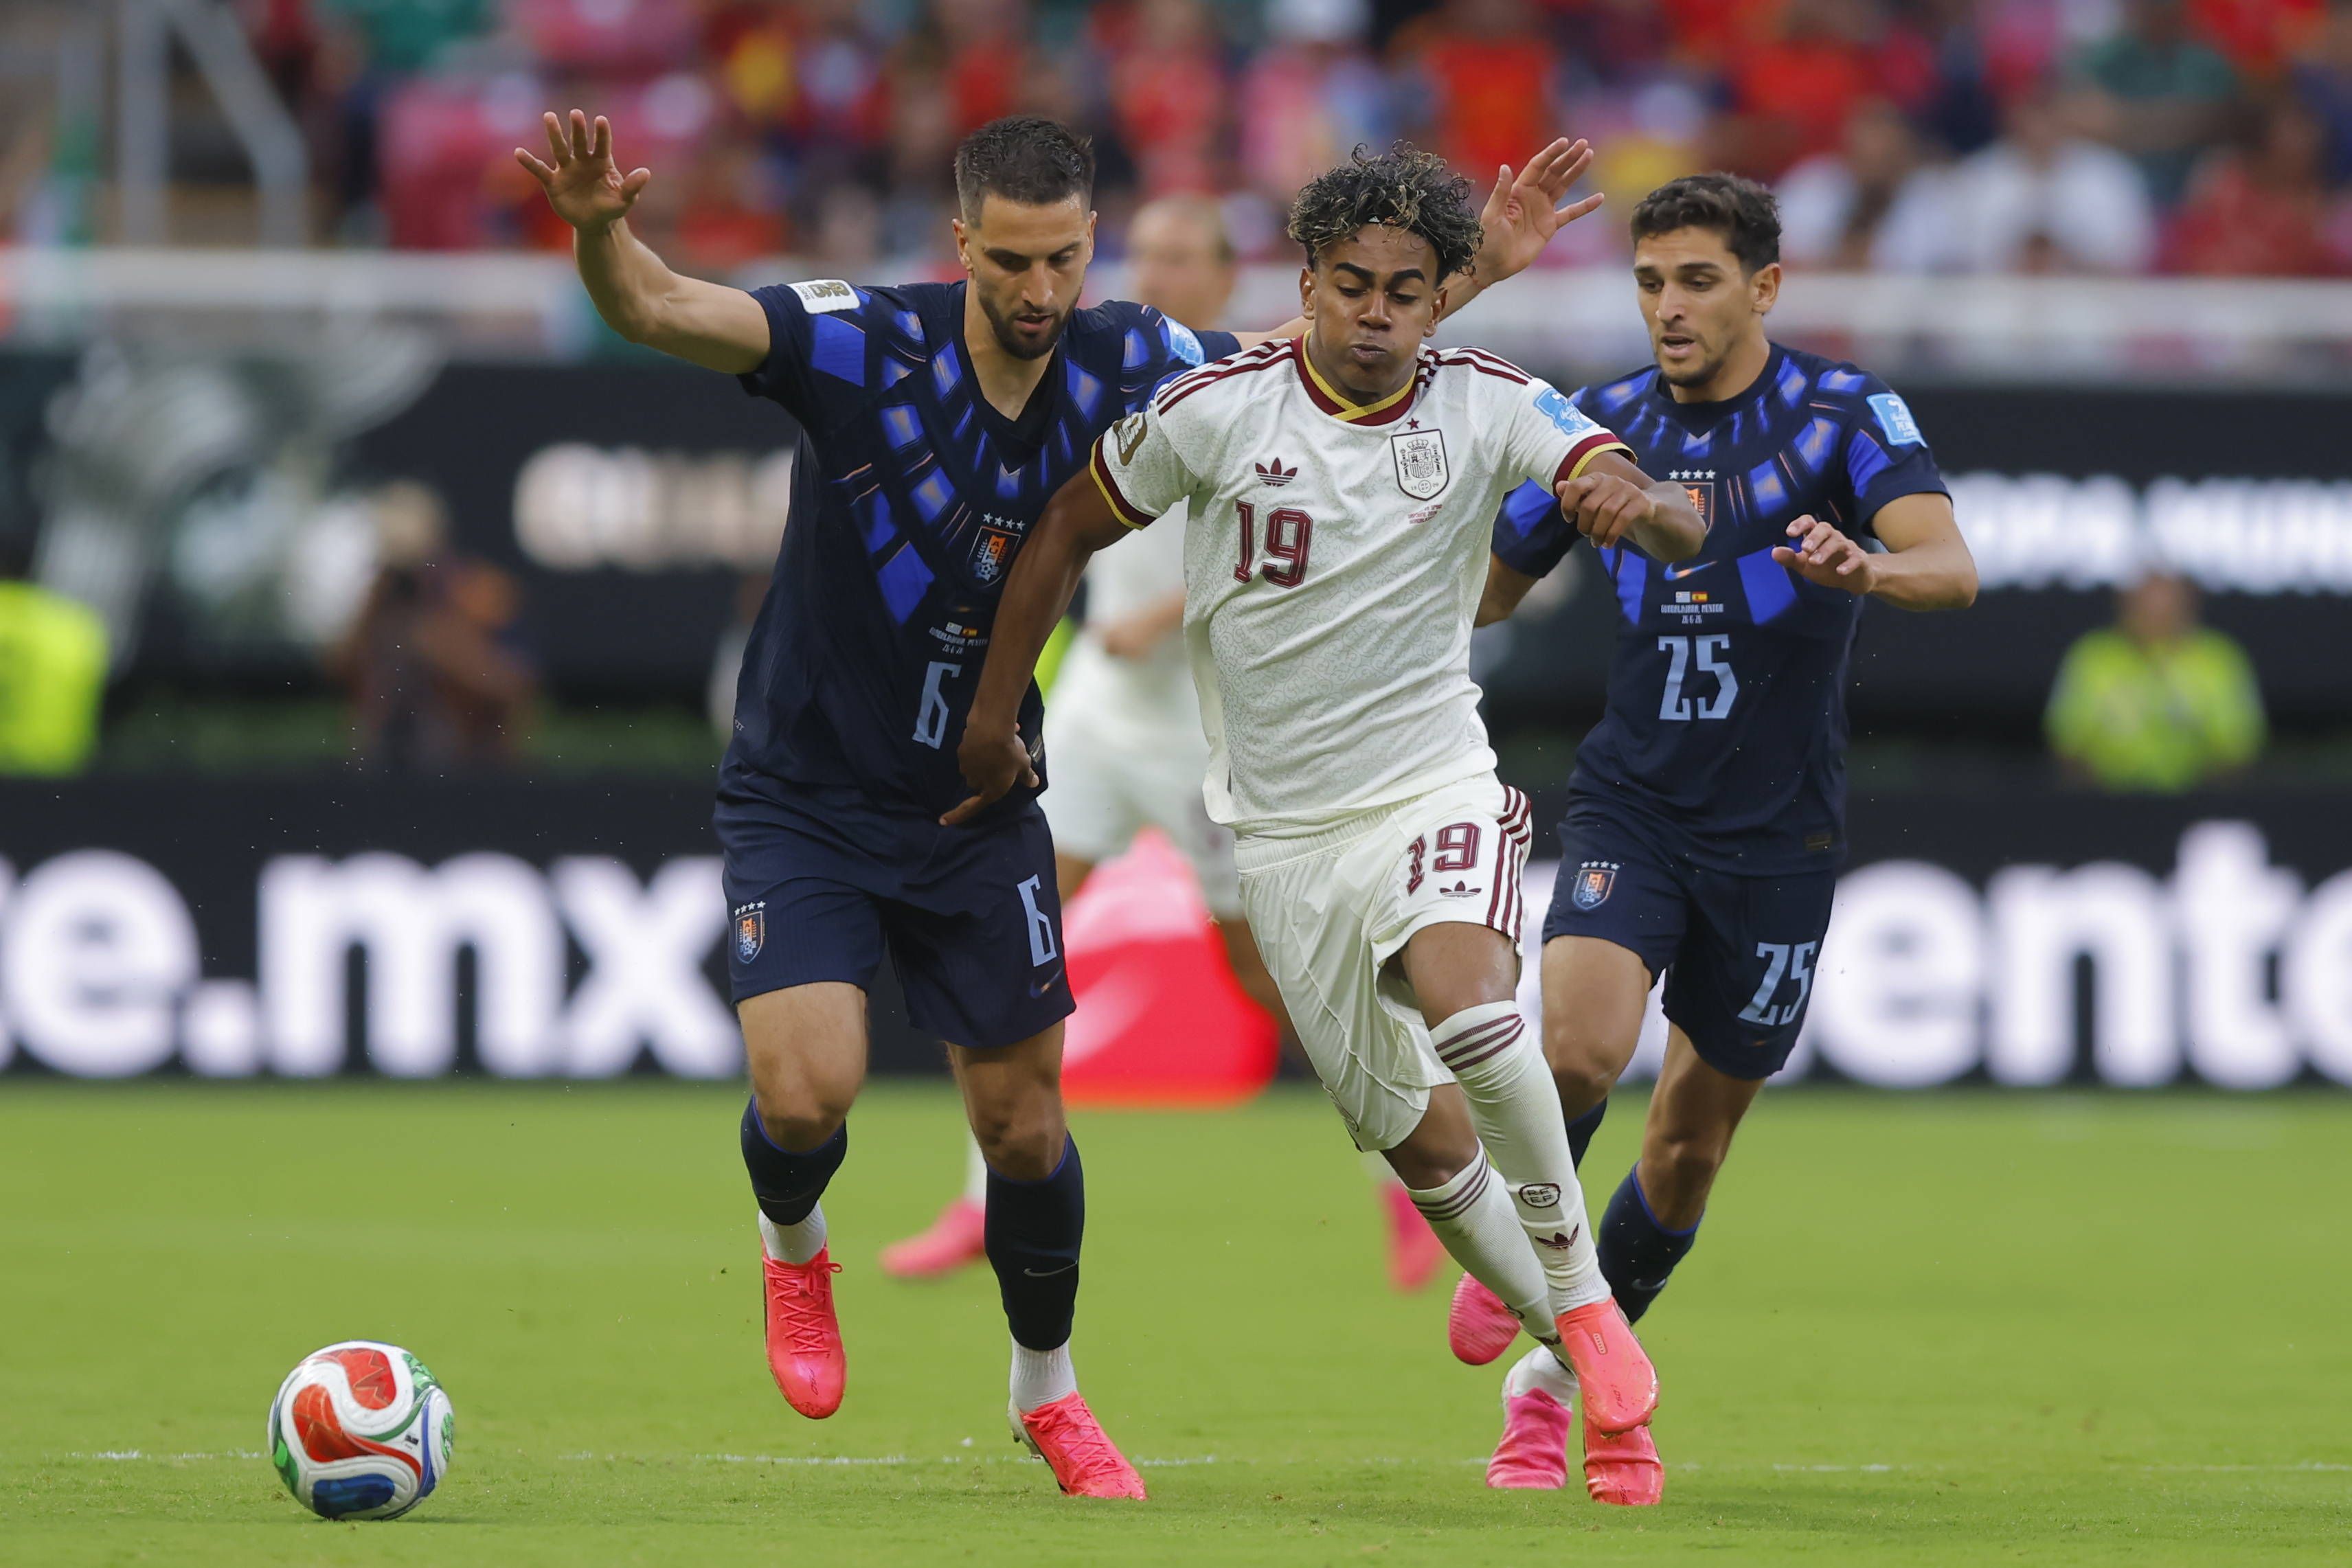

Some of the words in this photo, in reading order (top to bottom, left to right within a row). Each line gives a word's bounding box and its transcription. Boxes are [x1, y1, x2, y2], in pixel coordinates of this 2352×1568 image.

[1233, 499, 1313, 589] 19
[912, 660, 962, 750] 6
[1657, 633, 1739, 721] 25
[1406, 822, 1482, 898] 19
[0, 846, 747, 1081] e.mx
[1017, 873, 1058, 968] 6
[1737, 940, 1818, 1026] 25
